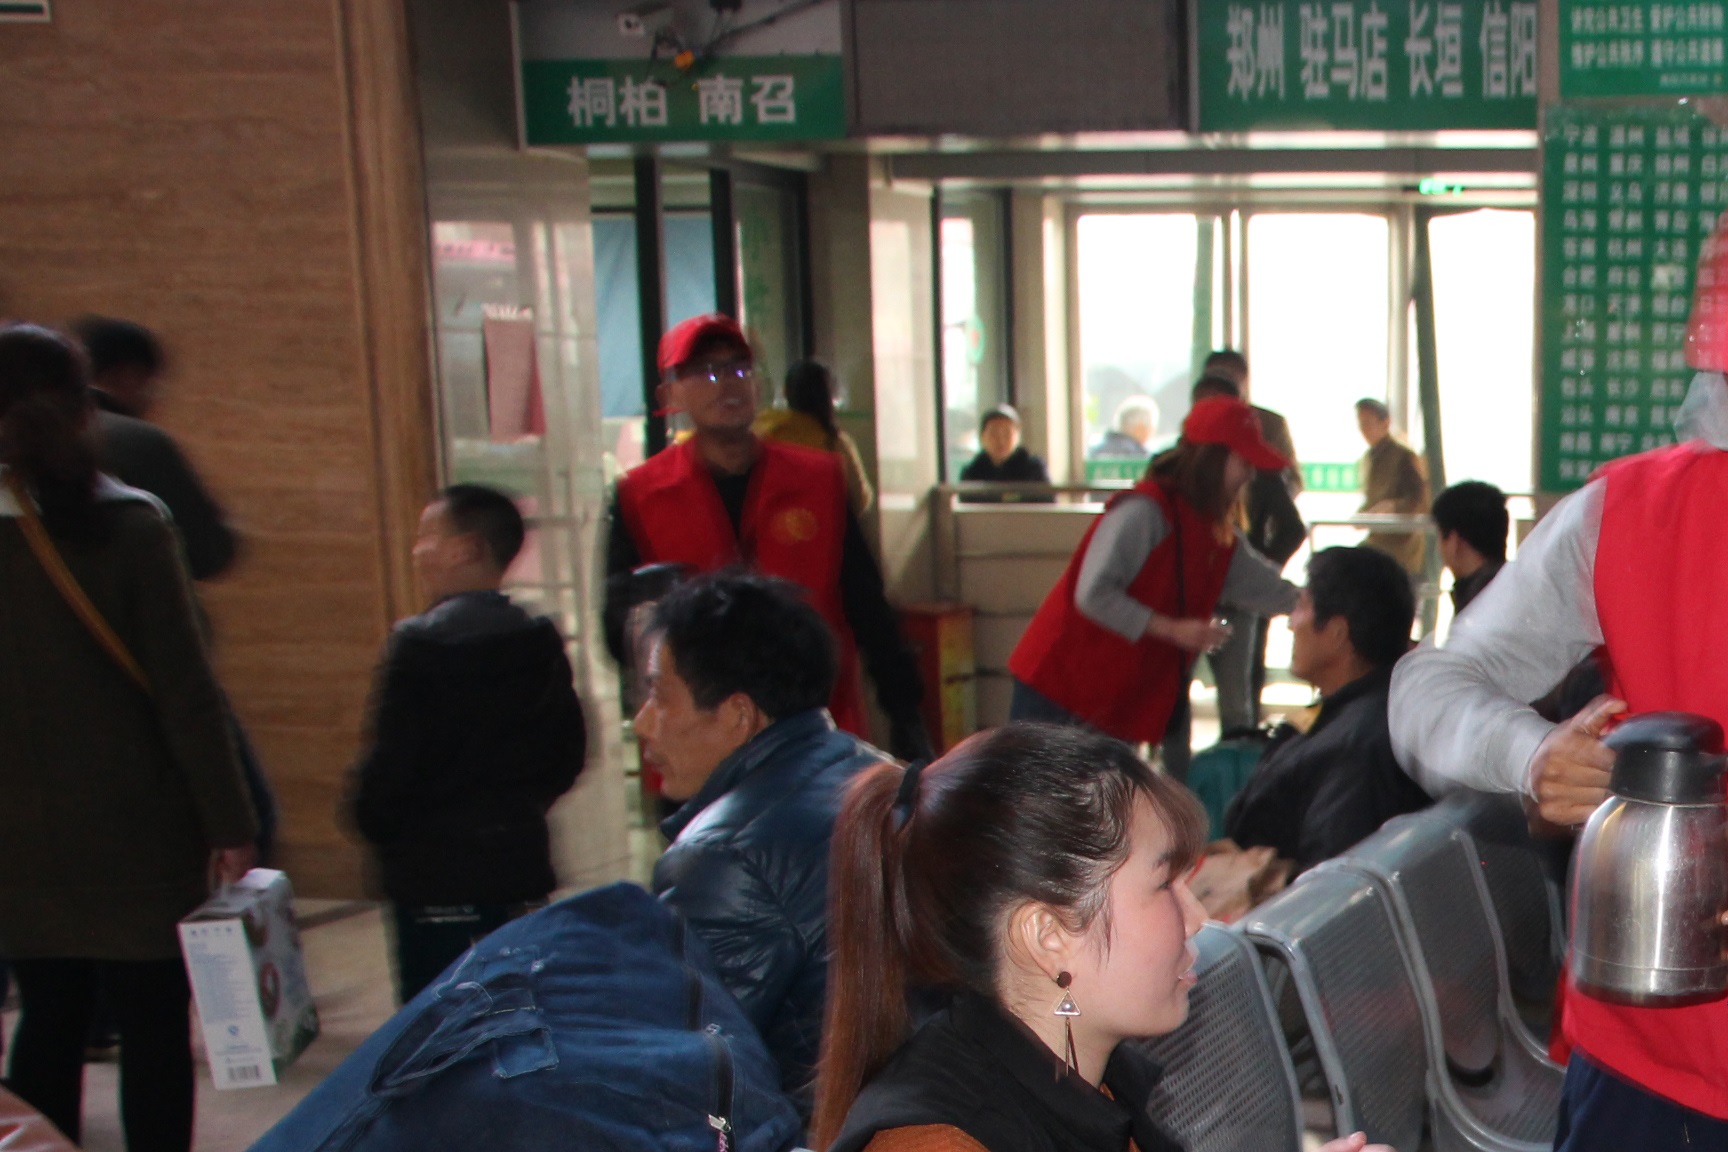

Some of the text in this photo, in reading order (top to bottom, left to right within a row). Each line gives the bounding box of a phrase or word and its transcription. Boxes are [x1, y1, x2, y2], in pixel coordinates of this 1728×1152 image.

[1226, 0, 1537, 99] 郑州 驻马店 长垣 信阳
[567, 74, 796, 127] 桐柏 南召
